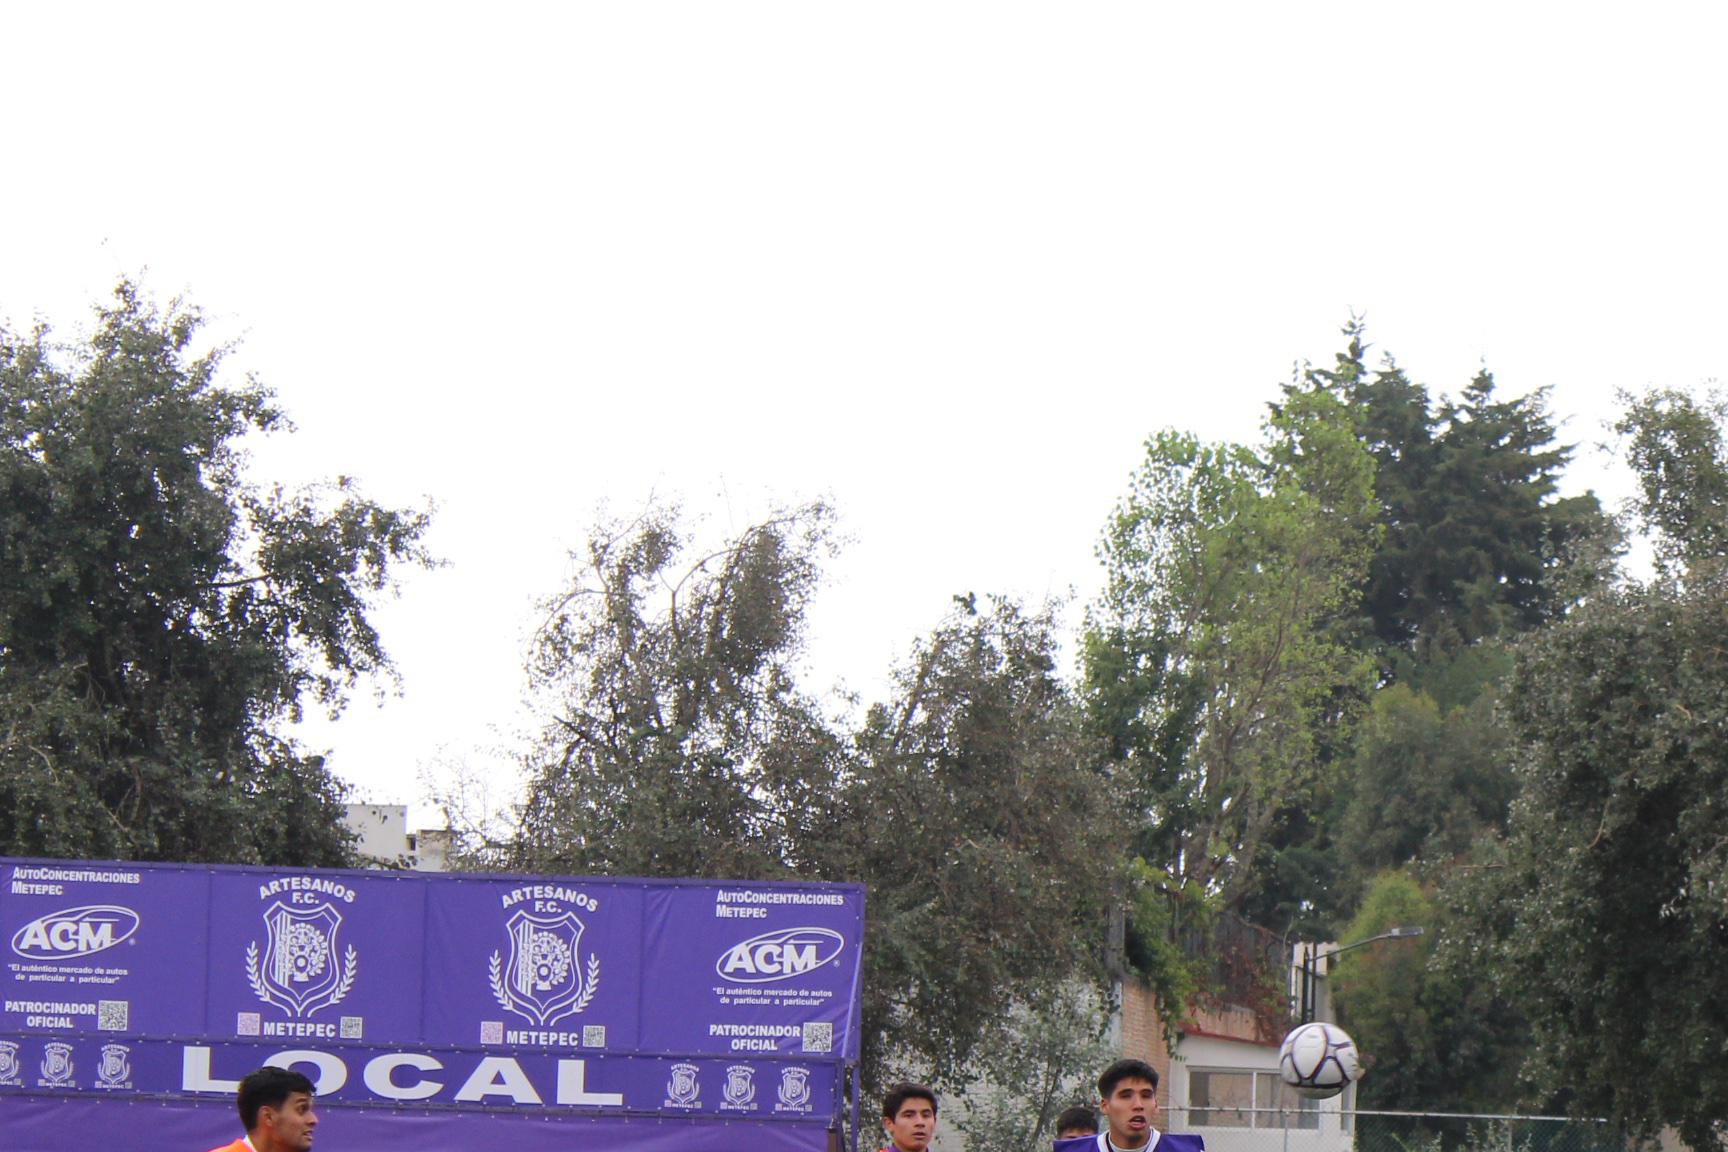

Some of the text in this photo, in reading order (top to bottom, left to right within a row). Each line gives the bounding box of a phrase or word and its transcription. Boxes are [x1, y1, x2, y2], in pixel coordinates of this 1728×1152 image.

[13, 867, 140, 883] AUTOCONCENTRACIONES
[12, 881, 63, 895] METEPEC
[259, 877, 356, 903] ARTESANOS
[292, 892, 320, 904] F.C.
[502, 886, 598, 912] ARTESANOS
[716, 890, 844, 906] AUTOCONCENTRACIONES
[535, 901, 562, 913] F.C.
[715, 904, 767, 918] METEPEC
[19, 920, 113, 951] ACM
[723, 943, 818, 975] ACM
[59, 966, 93, 974] mercado
[29, 974, 66, 982] particular
[5, 1001, 96, 1015] PATROCINADOR
[734, 997, 771, 1005] particular
[27, 1016, 73, 1028] OFICIAL
[263, 1021, 336, 1038] METEPEC
[709, 1024, 801, 1037] PATROCINADOR
[506, 1030, 579, 1047] METEPEC
[731, 1039, 778, 1051] OFICIAL
[182, 1046, 623, 1106] LOCAL
